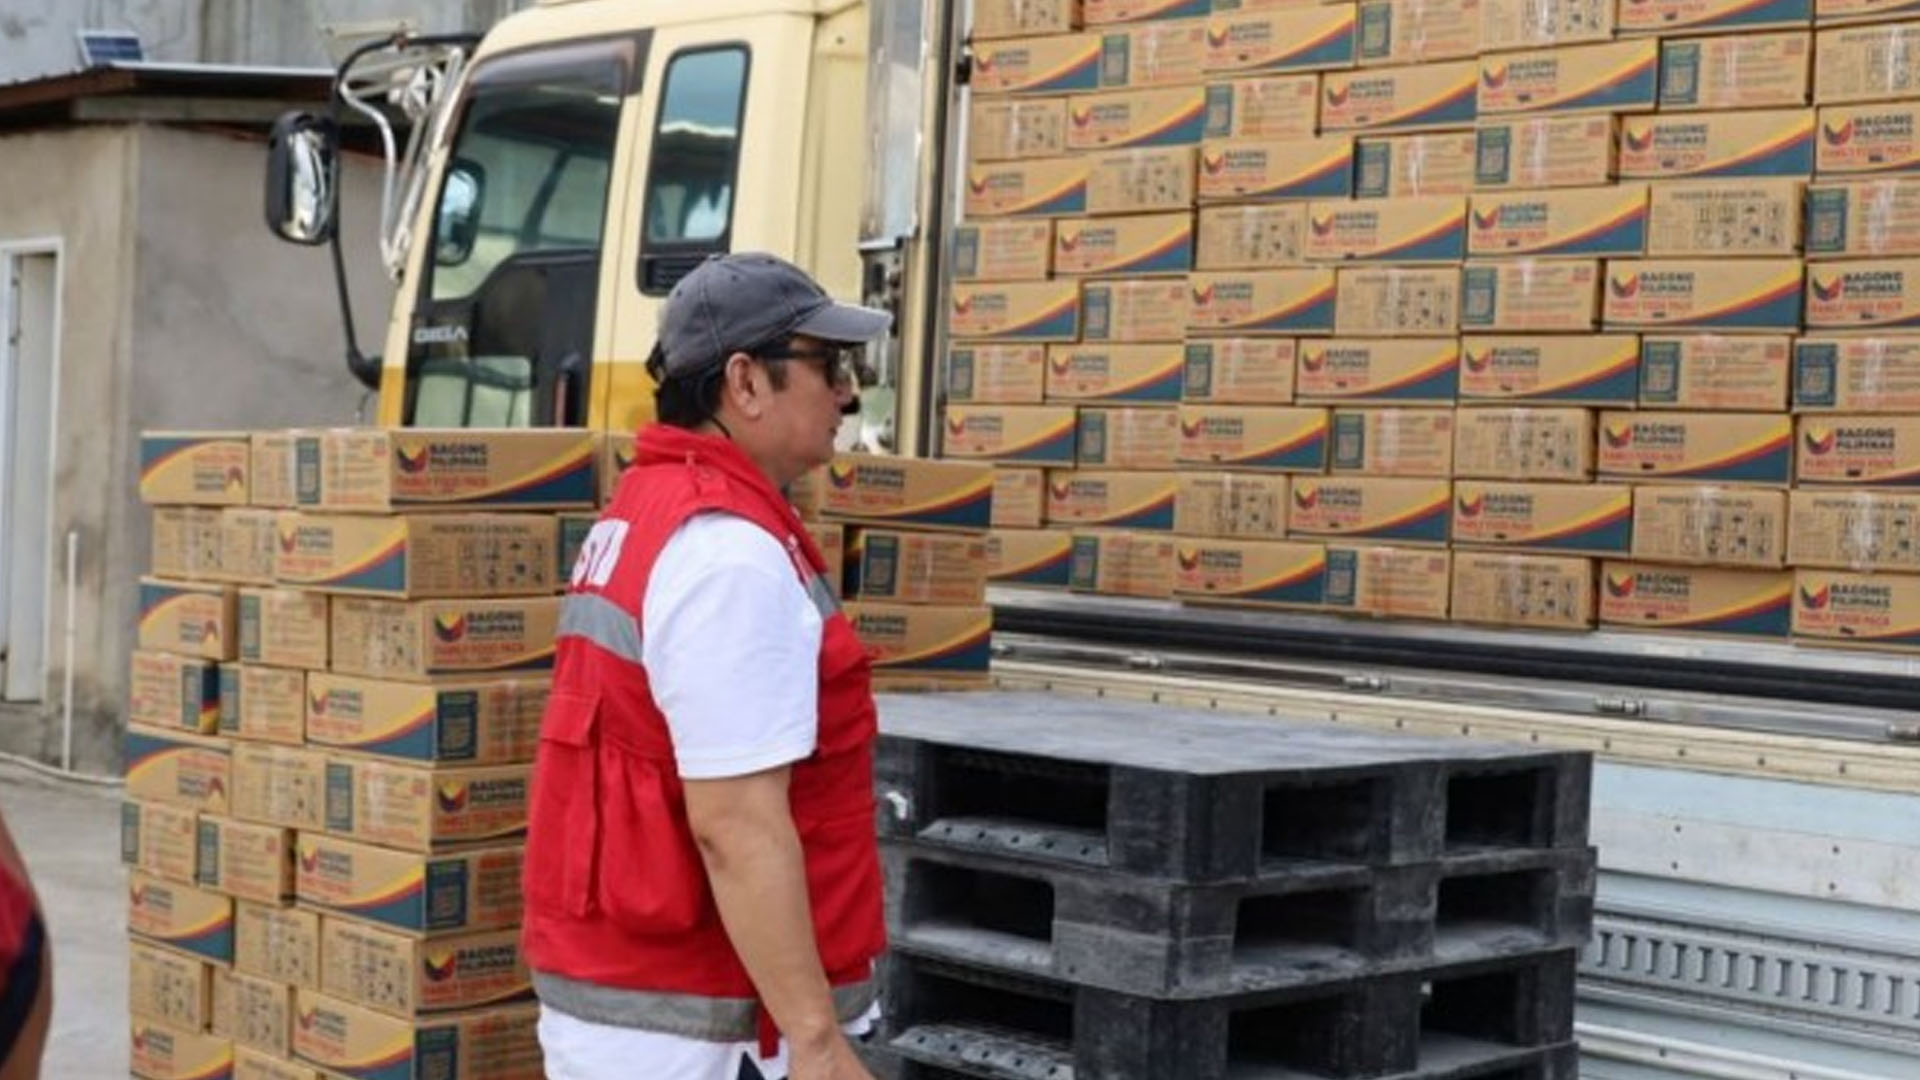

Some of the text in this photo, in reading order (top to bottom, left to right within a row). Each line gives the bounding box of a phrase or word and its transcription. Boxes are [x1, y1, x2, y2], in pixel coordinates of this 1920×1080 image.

[1841, 270, 1904, 282] BAGONG
[1835, 427, 1896, 439] BAGONG
[429, 442, 488, 455] BAGONG
[1835, 439, 1896, 450] PILIPINAS
[1830, 583, 1892, 597] BAGONG
[1830, 596, 1891, 609] PILIPINAS
